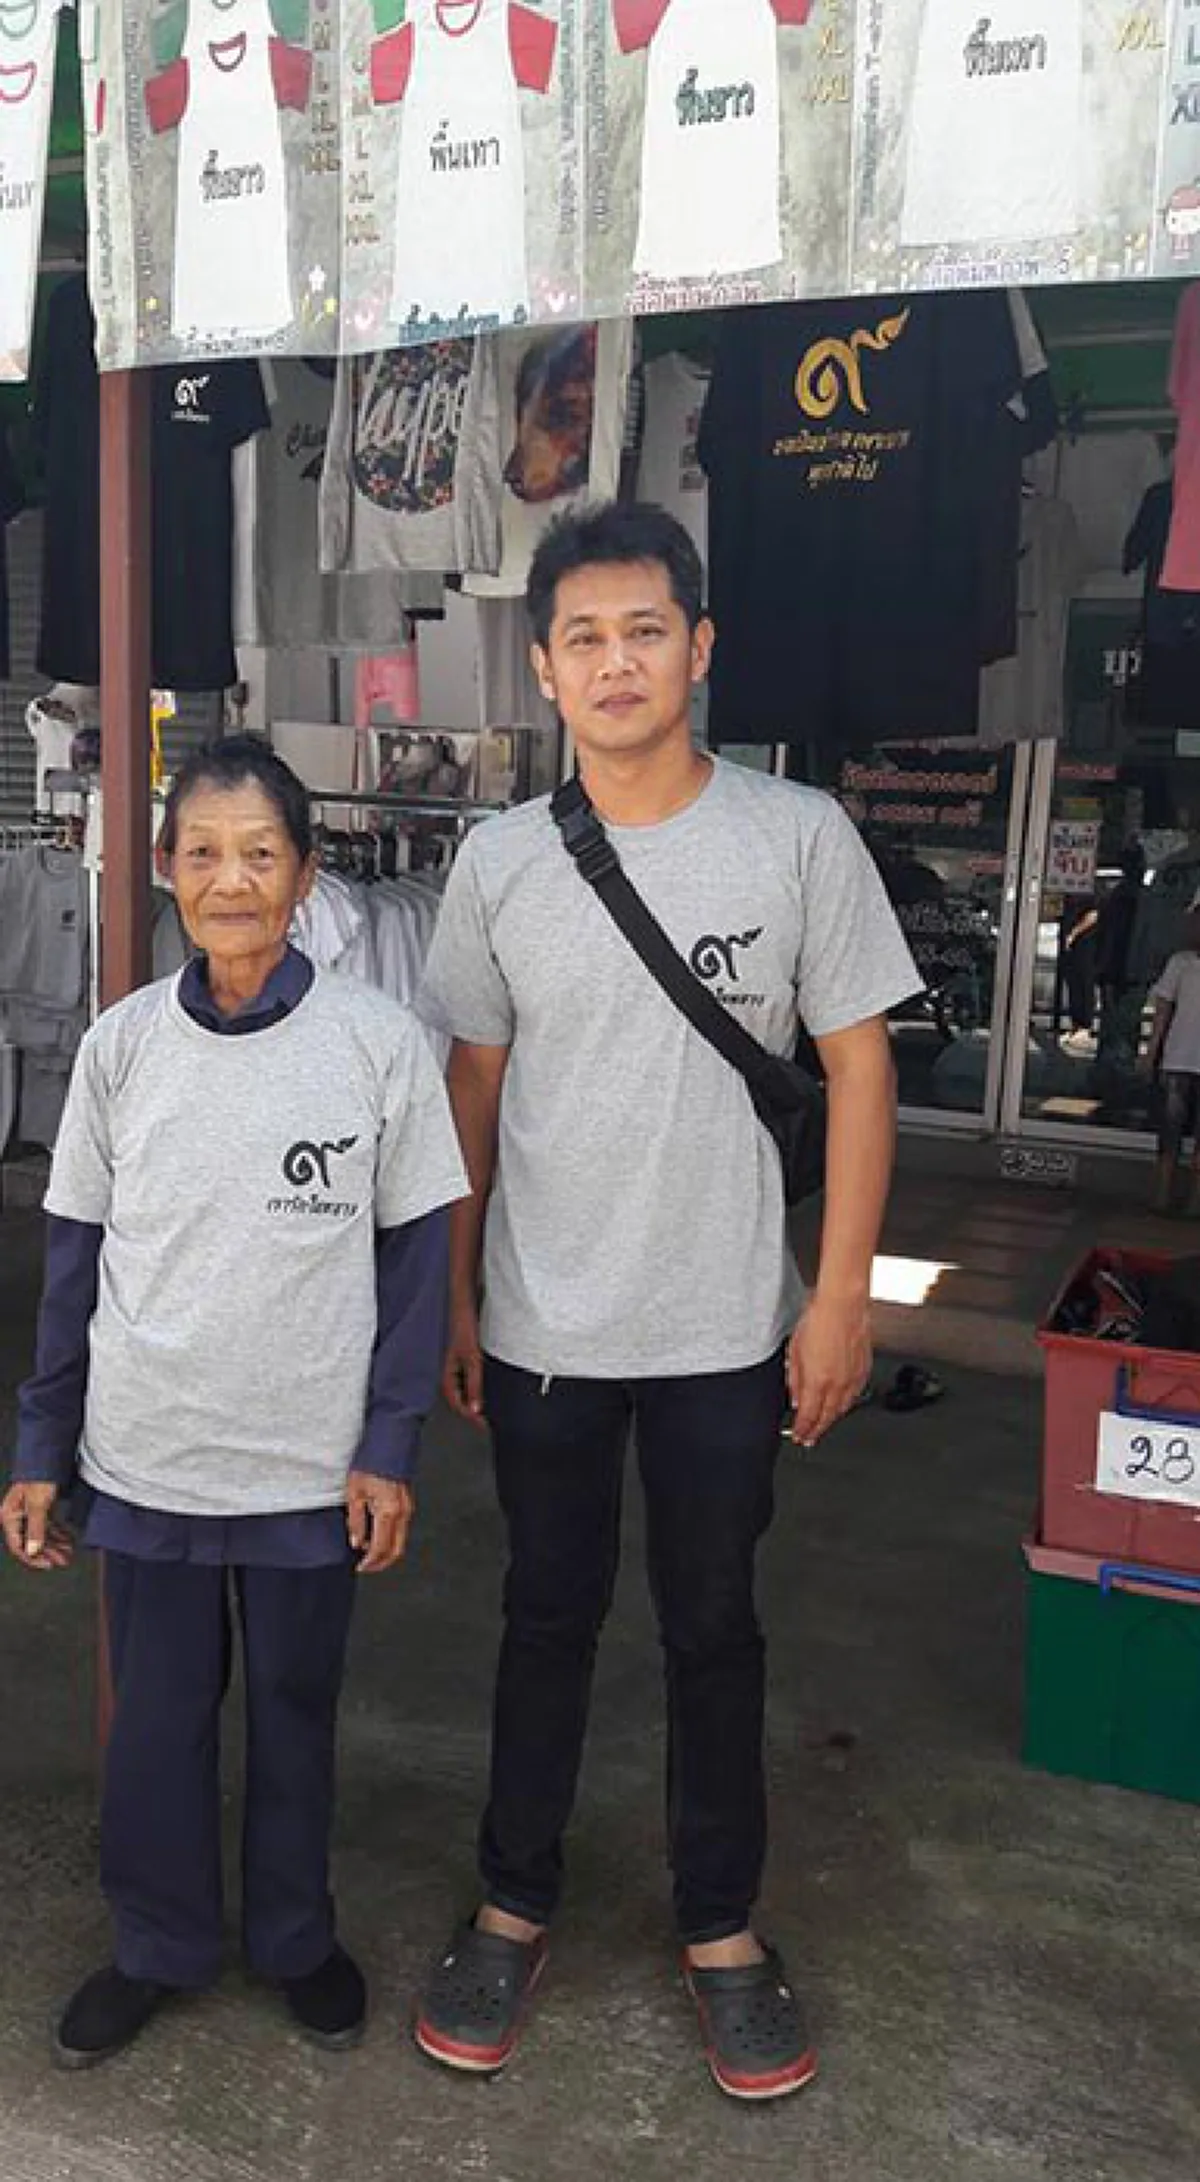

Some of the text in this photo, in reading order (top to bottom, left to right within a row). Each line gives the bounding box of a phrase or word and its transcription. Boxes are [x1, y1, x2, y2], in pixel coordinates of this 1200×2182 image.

[675, 66, 755, 126] พื้นขาว
[429, 119, 500, 172] พื้นเทา
[1125, 1435, 1195, 1485] 28
